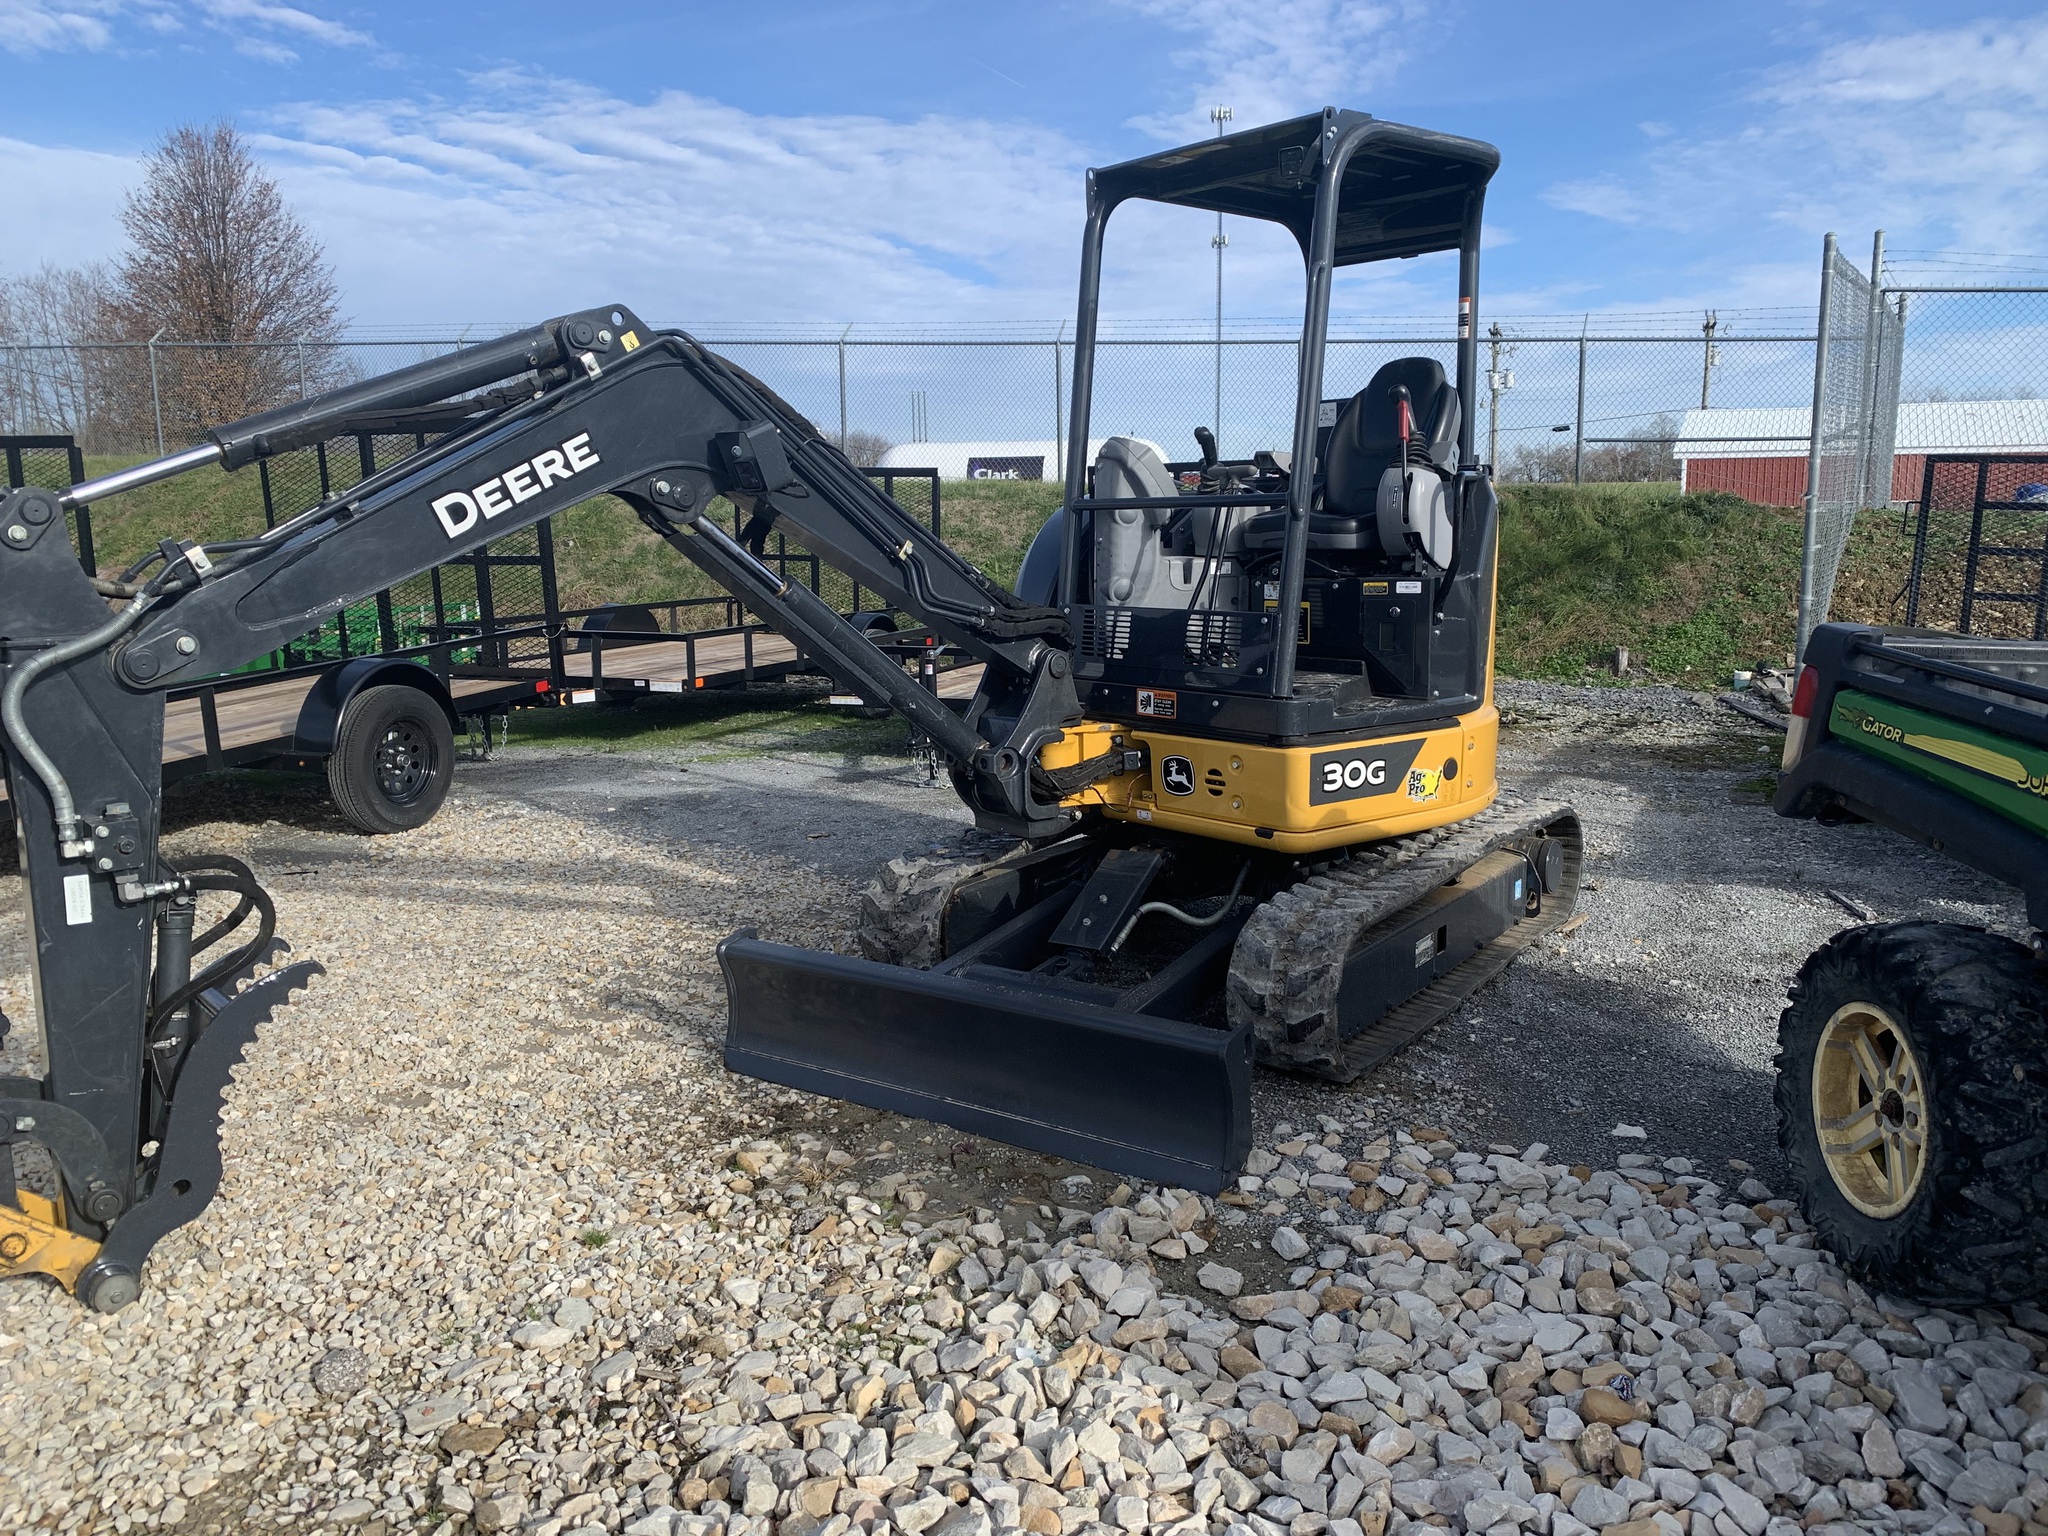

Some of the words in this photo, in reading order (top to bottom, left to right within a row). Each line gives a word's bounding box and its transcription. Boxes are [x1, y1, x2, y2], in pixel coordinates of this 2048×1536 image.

[973, 468, 1019, 480] Clark
[431, 432, 600, 539] DEERE
[1862, 716, 1902, 743] GATOR
[1323, 759, 1386, 792] 30G
[1408, 770, 1426, 784] Ag-
[1408, 783, 1426, 795] Pro
